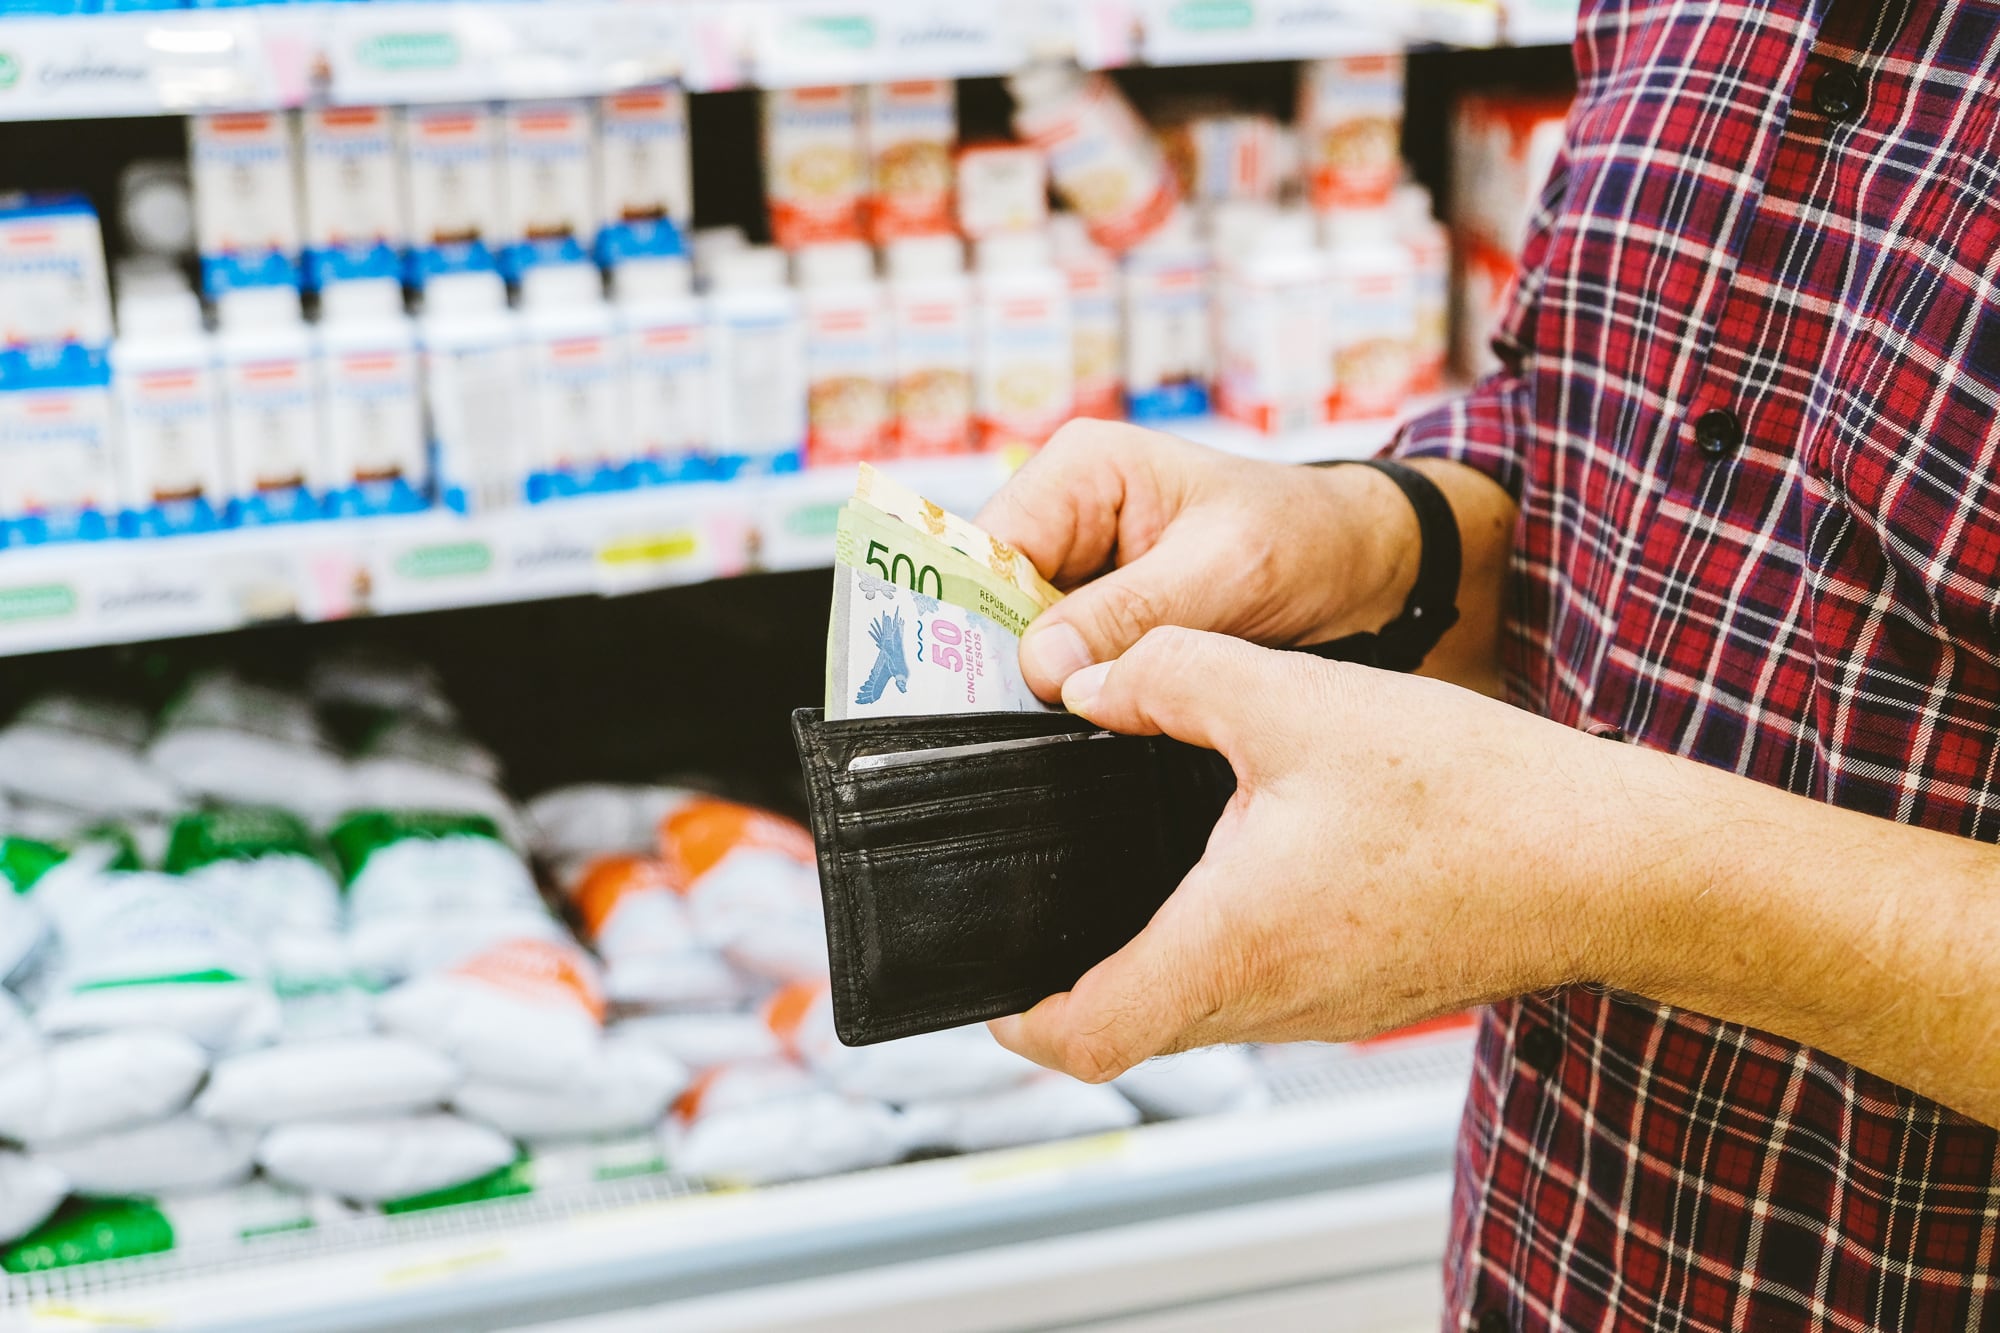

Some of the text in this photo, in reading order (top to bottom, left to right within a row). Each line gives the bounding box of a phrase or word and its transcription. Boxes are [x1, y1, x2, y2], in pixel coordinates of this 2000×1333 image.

[866, 540, 942, 600] 500
[980, 604, 990, 615] en
[931, 619, 963, 672] 50
[964, 629, 976, 703] CINCUENTA
[974, 633, 984, 677] PESOS
